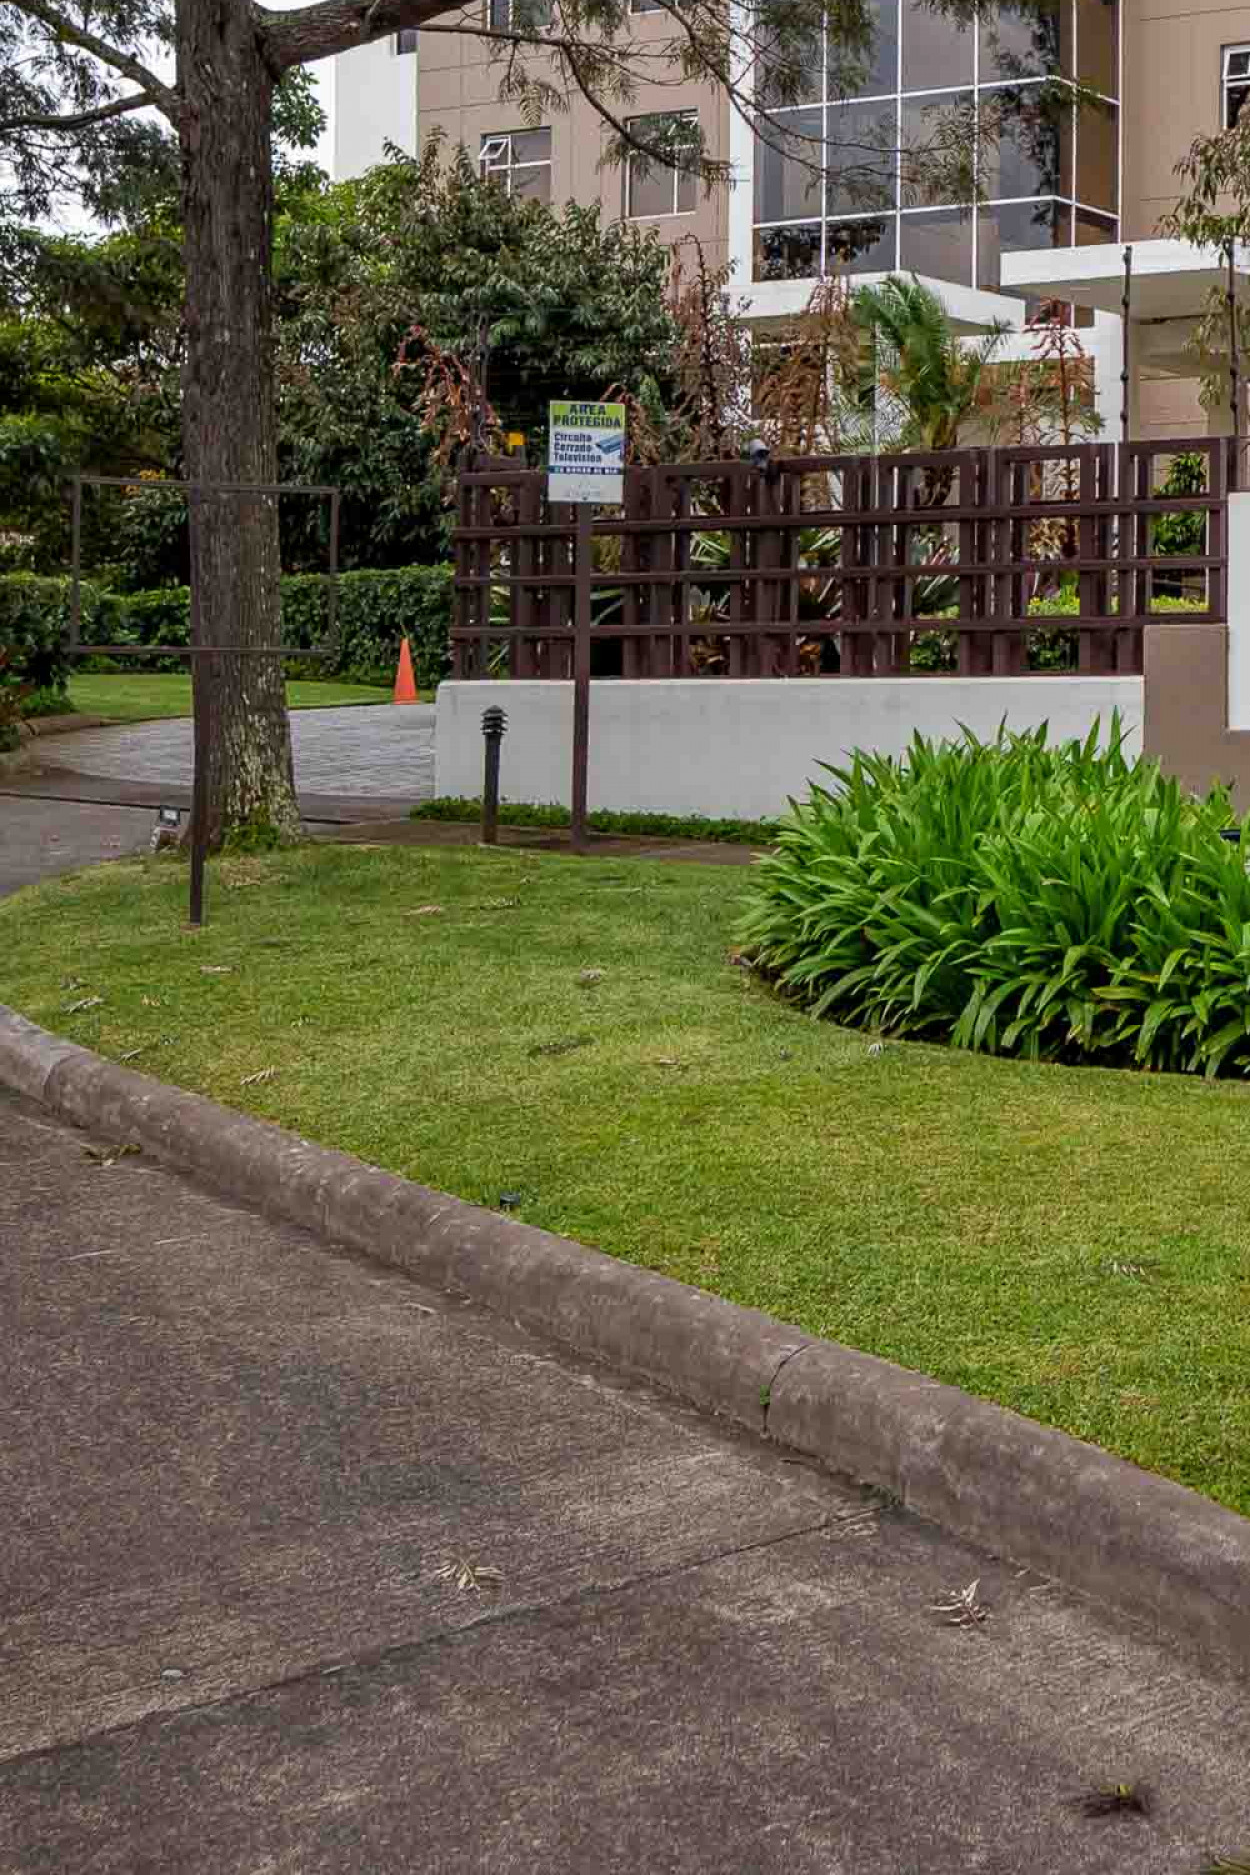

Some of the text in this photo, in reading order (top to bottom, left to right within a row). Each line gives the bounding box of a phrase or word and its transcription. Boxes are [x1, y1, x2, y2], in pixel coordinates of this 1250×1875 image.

[553, 415, 621, 427] PROTEGIDA
[554, 432, 592, 442] Circuito
[554, 442, 592, 452] Cerrado
